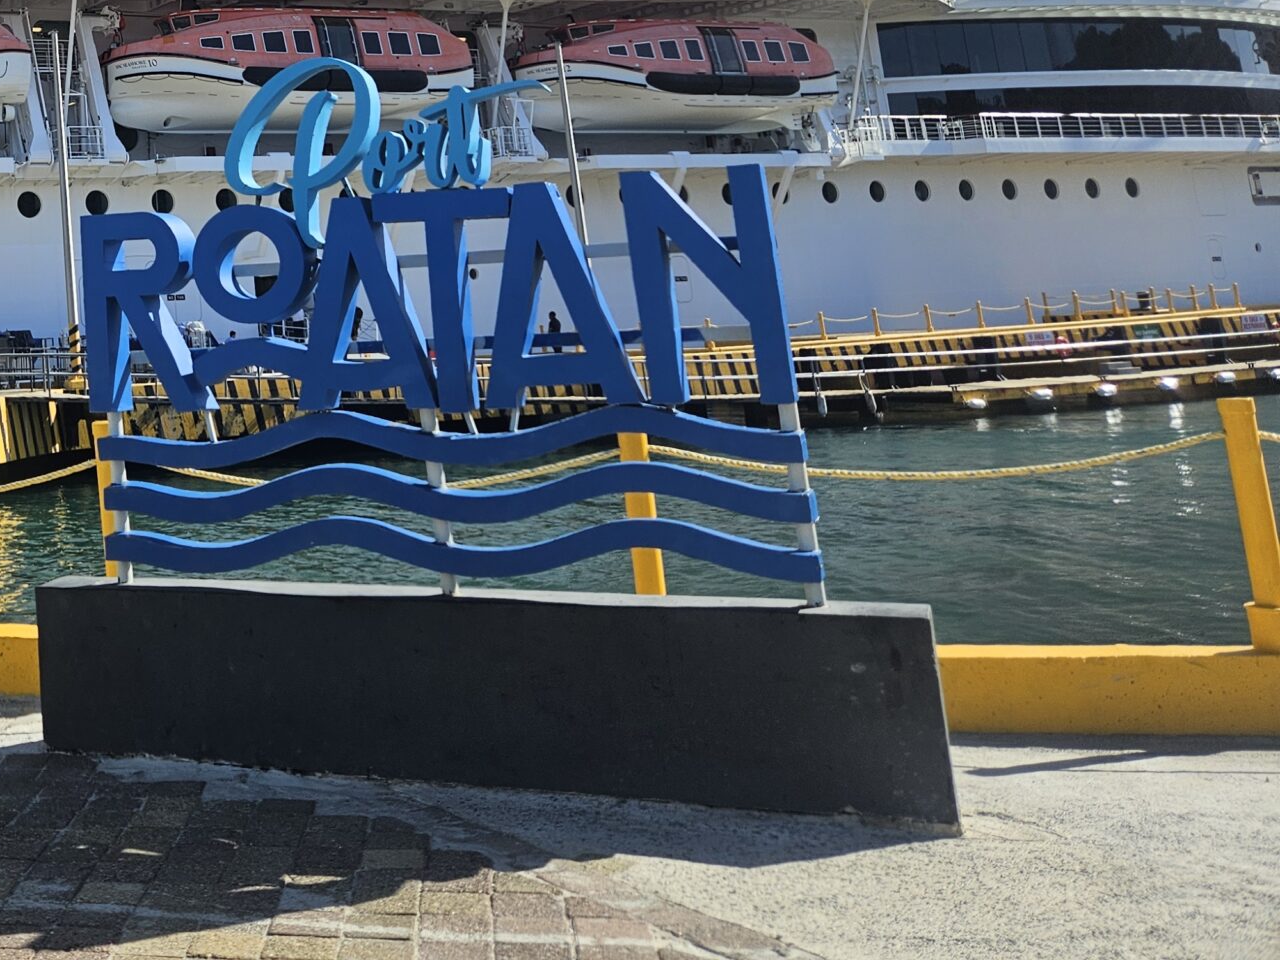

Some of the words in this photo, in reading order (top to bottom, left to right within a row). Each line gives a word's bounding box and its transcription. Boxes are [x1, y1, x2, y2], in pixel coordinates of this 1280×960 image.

[147, 59, 158, 67] 10
[224, 57, 551, 249] Port
[80, 163, 799, 415] ROATAN
